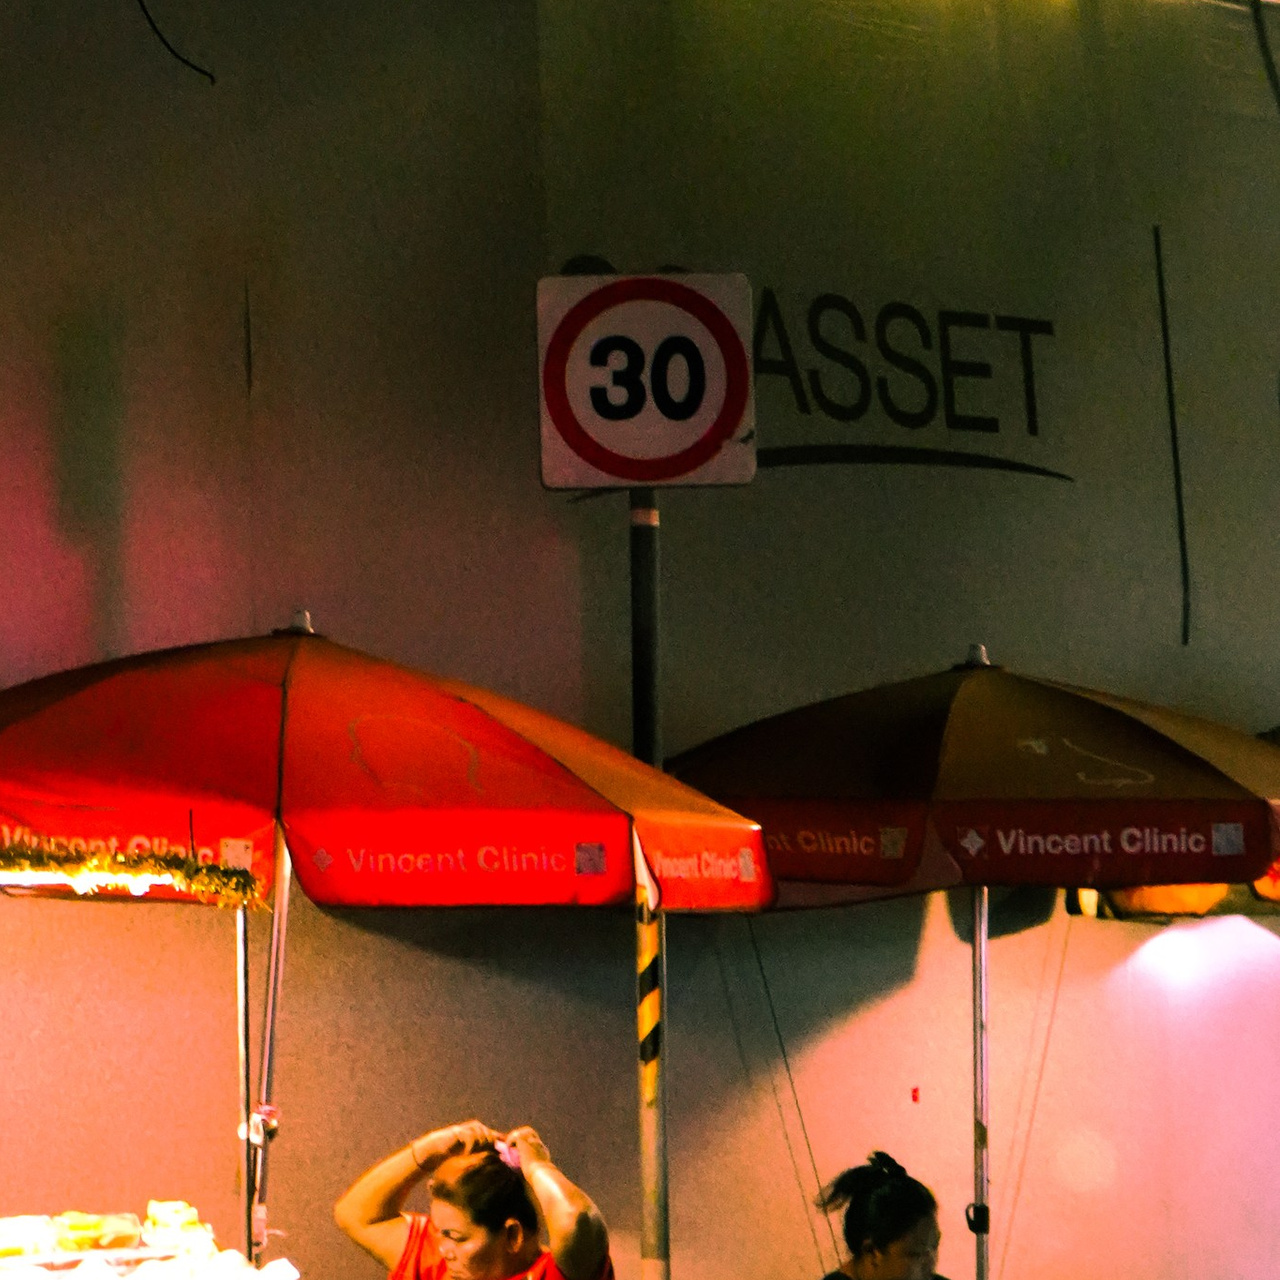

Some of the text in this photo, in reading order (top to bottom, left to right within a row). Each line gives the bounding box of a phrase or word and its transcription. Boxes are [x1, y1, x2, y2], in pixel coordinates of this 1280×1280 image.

[752, 287, 1055, 436] ASSET
[588, 334, 707, 421] 30
[796, 829, 876, 856] Clinic
[996, 825, 1206, 855] Vincent Clinic
[346, 845, 567, 874] Vincent Clinic
